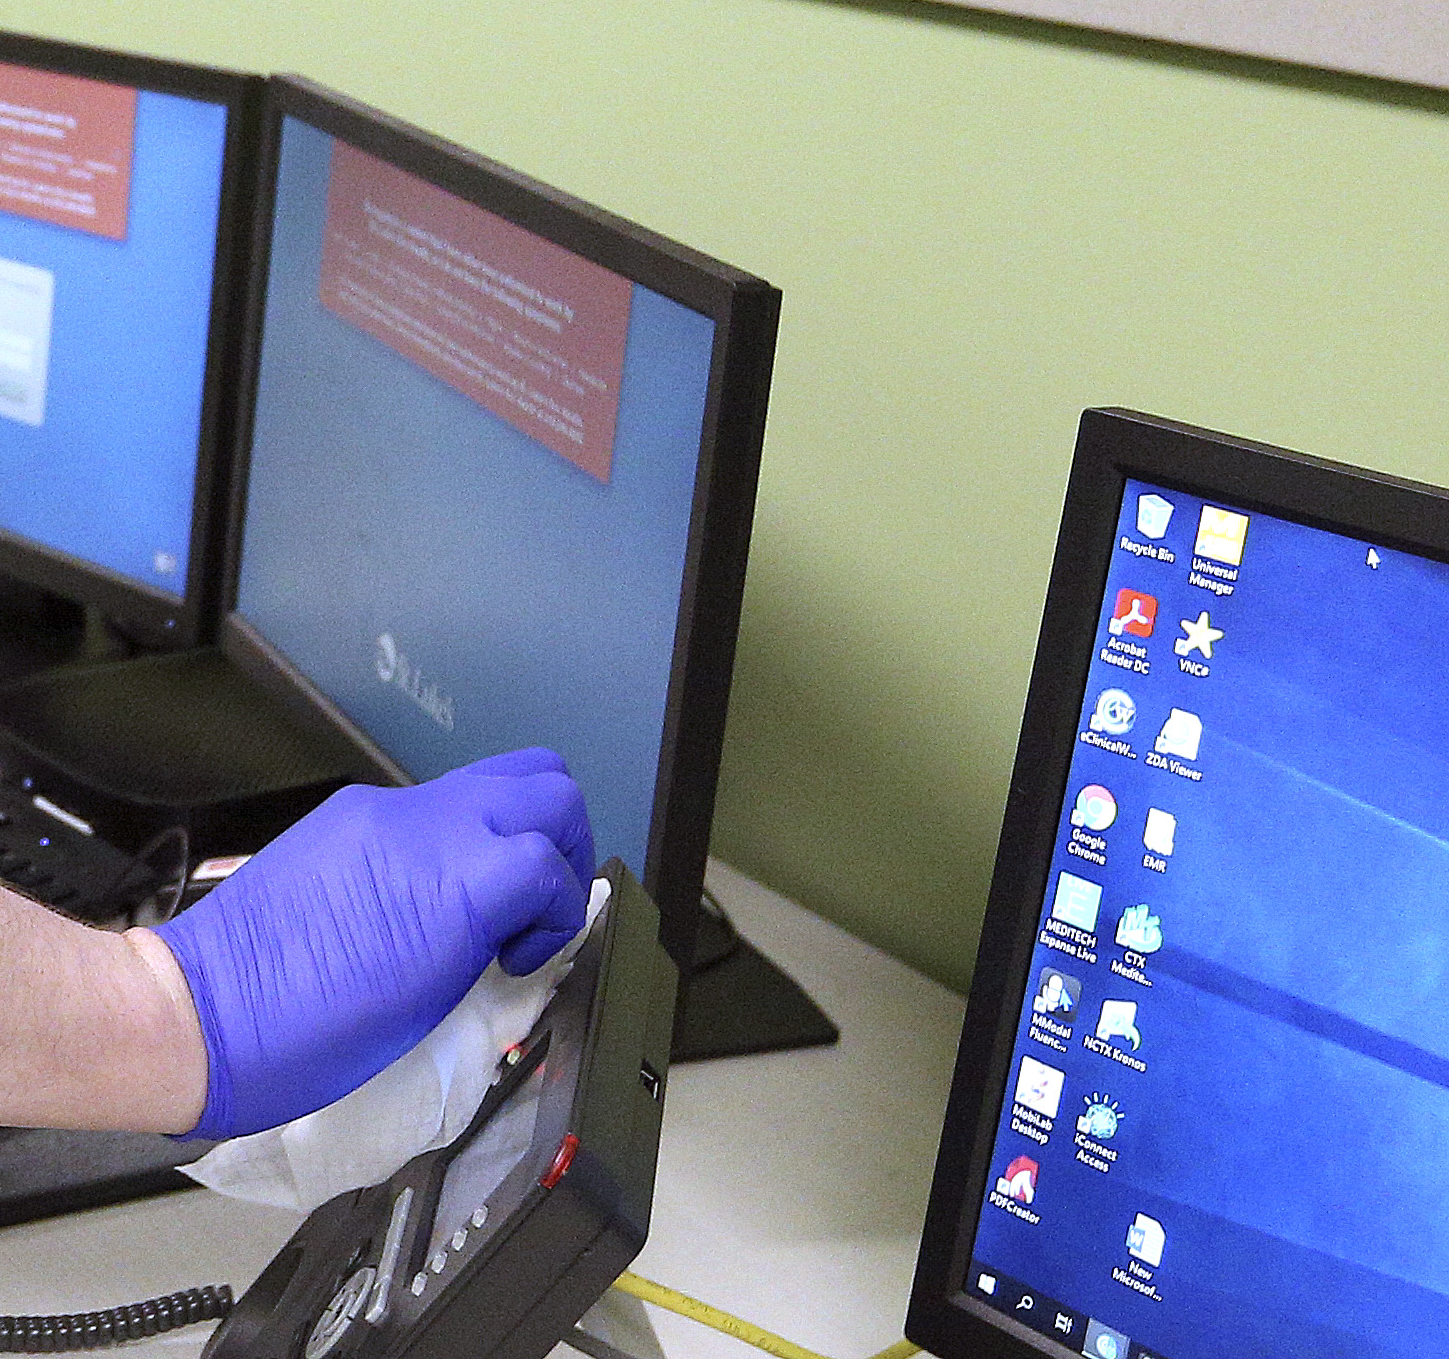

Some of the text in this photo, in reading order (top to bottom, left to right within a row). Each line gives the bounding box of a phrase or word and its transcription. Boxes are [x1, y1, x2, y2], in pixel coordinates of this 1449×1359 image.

[1121, 537, 1175, 563] Recycle Bin
[1193, 558, 1238, 580] Universal
[1189, 573, 1234, 595] Manager
[1107, 636, 1147, 658] Acrobat
[1100, 649, 1150, 674] Reader DC
[1146, 752, 1203, 781] ZDA Viewer
[1072, 828, 1107, 850] Google
[1068, 841, 1107, 865] Chrome
[1143, 855, 1167, 873] EMR
[1046, 918, 1097, 948] MEDITECH
[1039, 931, 1097, 963] Expanse Live
[1124, 952, 1146, 969] CTX
[1031, 1012, 1072, 1039] MModal
[1083, 1035, 1147, 1072] NCTX Kronos
[1013, 1104, 1053, 1131] MobiLab
[1011, 1118, 1049, 1146] Desktop
[1075, 1133, 1118, 1162] iConnect
[1076, 1150, 1109, 1173] Access
[1129, 1261, 1153, 1281] New
